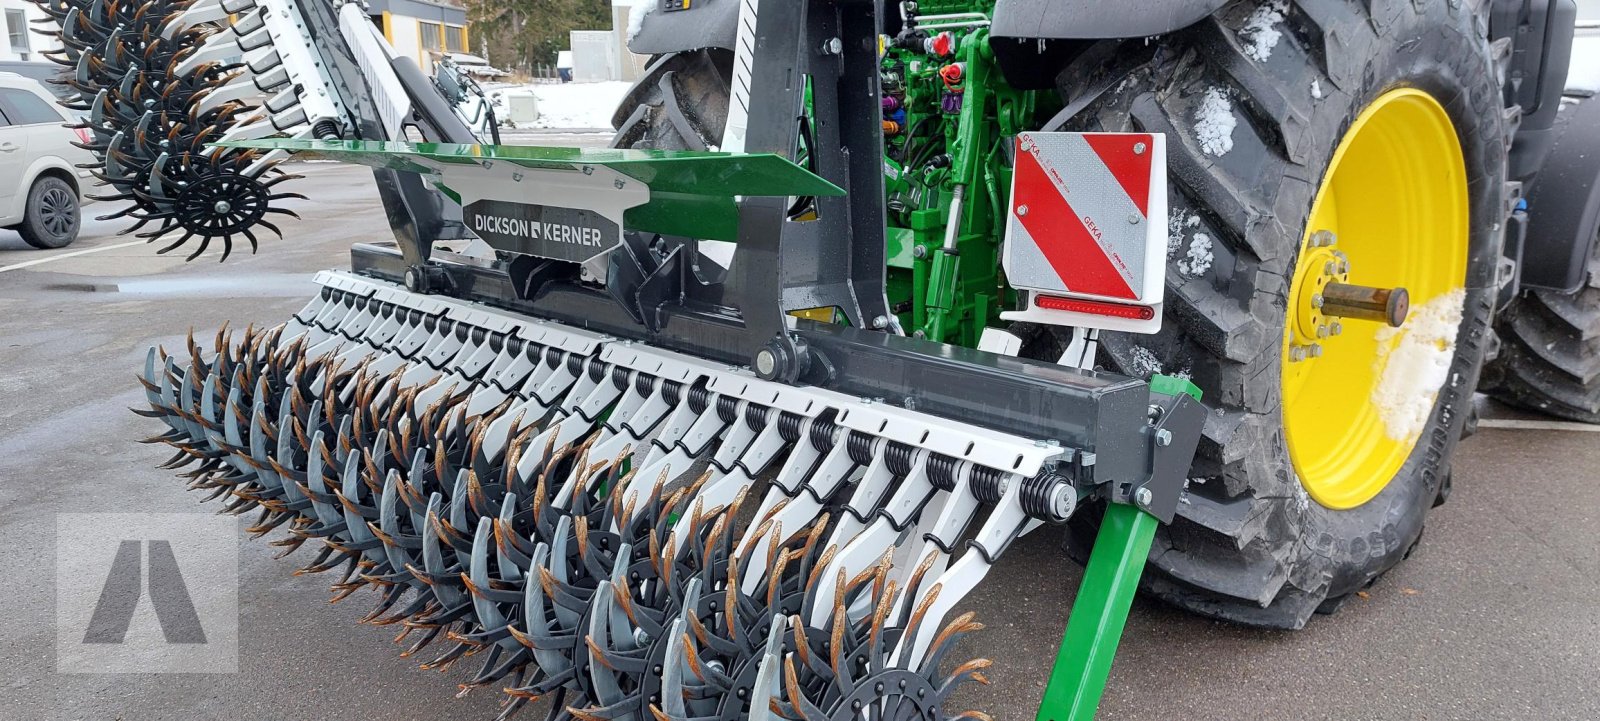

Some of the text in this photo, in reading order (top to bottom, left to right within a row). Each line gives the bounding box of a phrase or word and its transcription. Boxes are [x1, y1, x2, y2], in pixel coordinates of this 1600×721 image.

[475, 213, 602, 248] DICKSON KERNER
[1083, 216, 1103, 241] GEKA
